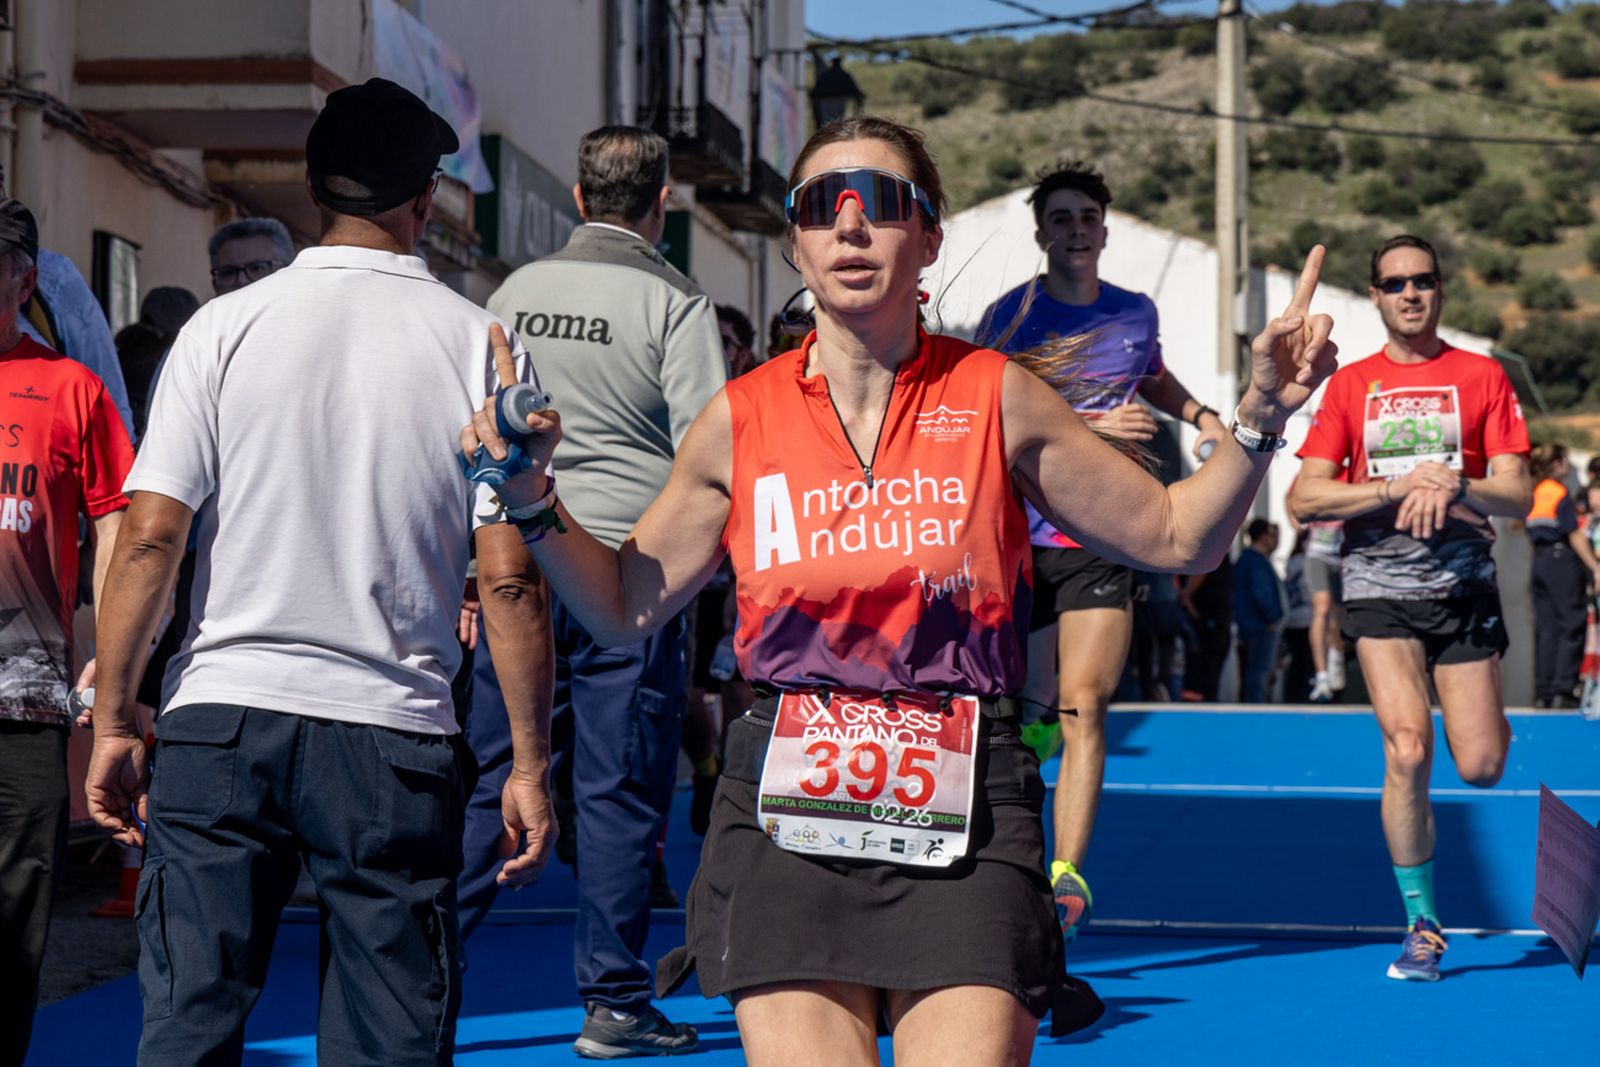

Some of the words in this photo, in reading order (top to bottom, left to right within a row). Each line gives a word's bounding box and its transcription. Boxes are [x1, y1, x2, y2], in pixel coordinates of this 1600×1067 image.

[514, 311, 613, 346] Joma
[918, 424, 971, 434] ANDÚJAR
[1379, 416, 1443, 449] 235
[0, 497, 33, 534] AS
[910, 552, 977, 602] trail
[841, 703, 943, 733] CROSS
[802, 723, 917, 748] PANTANO
[920, 736, 941, 749] DEL
[799, 740, 938, 808] 395
[762, 796, 797, 807] MARTA
[798, 799, 852, 813] GONZALEZ
[853, 804, 868, 814] DE
